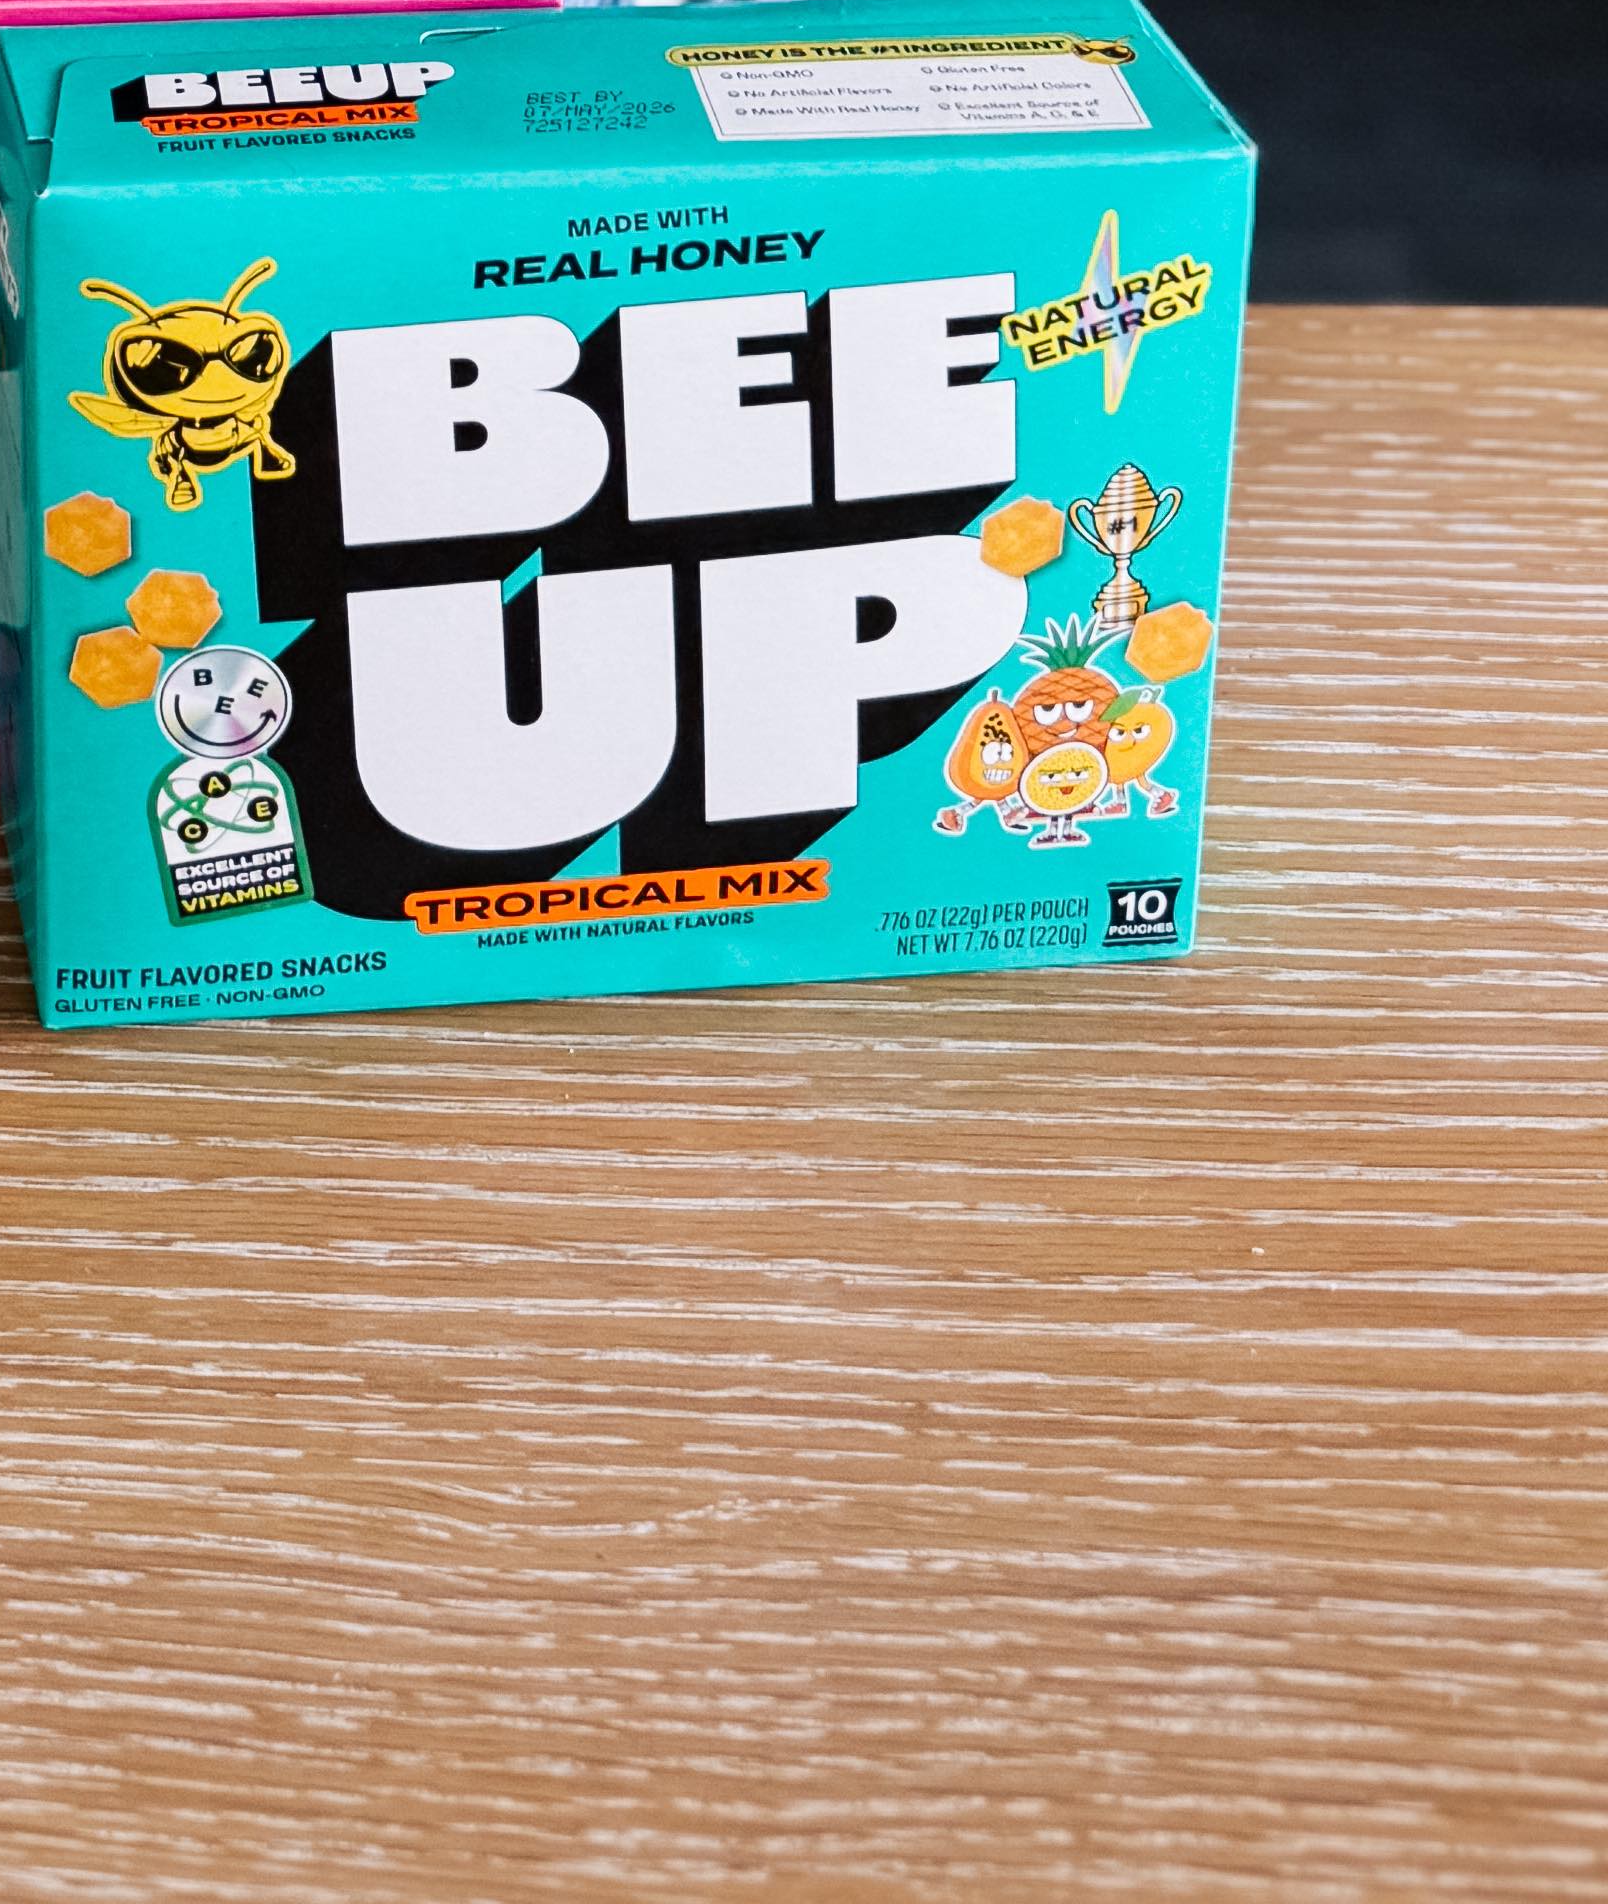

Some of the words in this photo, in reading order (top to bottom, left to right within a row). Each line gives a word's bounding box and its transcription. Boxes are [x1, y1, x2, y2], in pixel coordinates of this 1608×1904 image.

[681, 48, 774, 61] HONEY
[781, 47, 807, 57] IS
[811, 46, 865, 56] THE
[903, 40, 1066, 54] INGREDIENT
[144, 61, 455, 109] BEEUP
[526, 92, 581, 105] BEST
[595, 90, 622, 103] BY
[744, 90, 766, 98] No
[149, 110, 339, 133] TROPICAL
[347, 105, 413, 122] MIX
[524, 101, 676, 119] 07/MAY/2026
[158, 139, 217, 154] FRUIT
[223, 132, 327, 150] FLAVORED
[333, 128, 417, 143] SNACKS
[568, 212, 650, 238] MADE
[657, 205, 729, 229] WITH
[473, 250, 618, 289] REAL
[630, 229, 825, 276] HONEY
[1008, 259, 1206, 341] NATURAL
[1028, 284, 1202, 365] ENERGY
[331, 272, 1017, 547] BEE
[1107, 516, 1138, 535] #1
[346, 535, 1029, 852] UP
[175, 847, 294, 880] EXCELLENT
[177, 872, 264, 897] SOURCE
[266, 863, 296, 881] OF
[181, 878, 300, 914] VITAMINS
[415, 878, 706, 925] TROPICAL
[718, 867, 819, 900] MIX
[1118, 890, 1167, 921] 10
[477, 931, 530, 949] MADE
[534, 926, 582, 943] WITH
[586, 918, 669, 939] NATURAL
[674, 911, 755, 930] FLAVORS
[874, 911, 911, 933] .776
[915, 908, 936, 929] OZ
[941, 903, 988, 930] (22g)
[992, 902, 1025, 924] PER
[1030, 896, 1090, 921] POUCH
[1108, 922, 1174, 937] POUCHES
[897, 934, 928, 956] NET
[934, 933, 959, 953] WT
[964, 931, 998, 952] 7.76
[1004, 928, 1024, 949] OZ
[1029, 922, 1088, 949] (220g)
[56, 968, 132, 991] FRUIT
[140, 961, 274, 989] FLAVORED
[281, 951, 387, 979] SNACKS
[55, 997, 142, 1014] GLUTEN
[147, 993, 201, 1010] FREE
[215, 984, 326, 1006] NON-GMO
